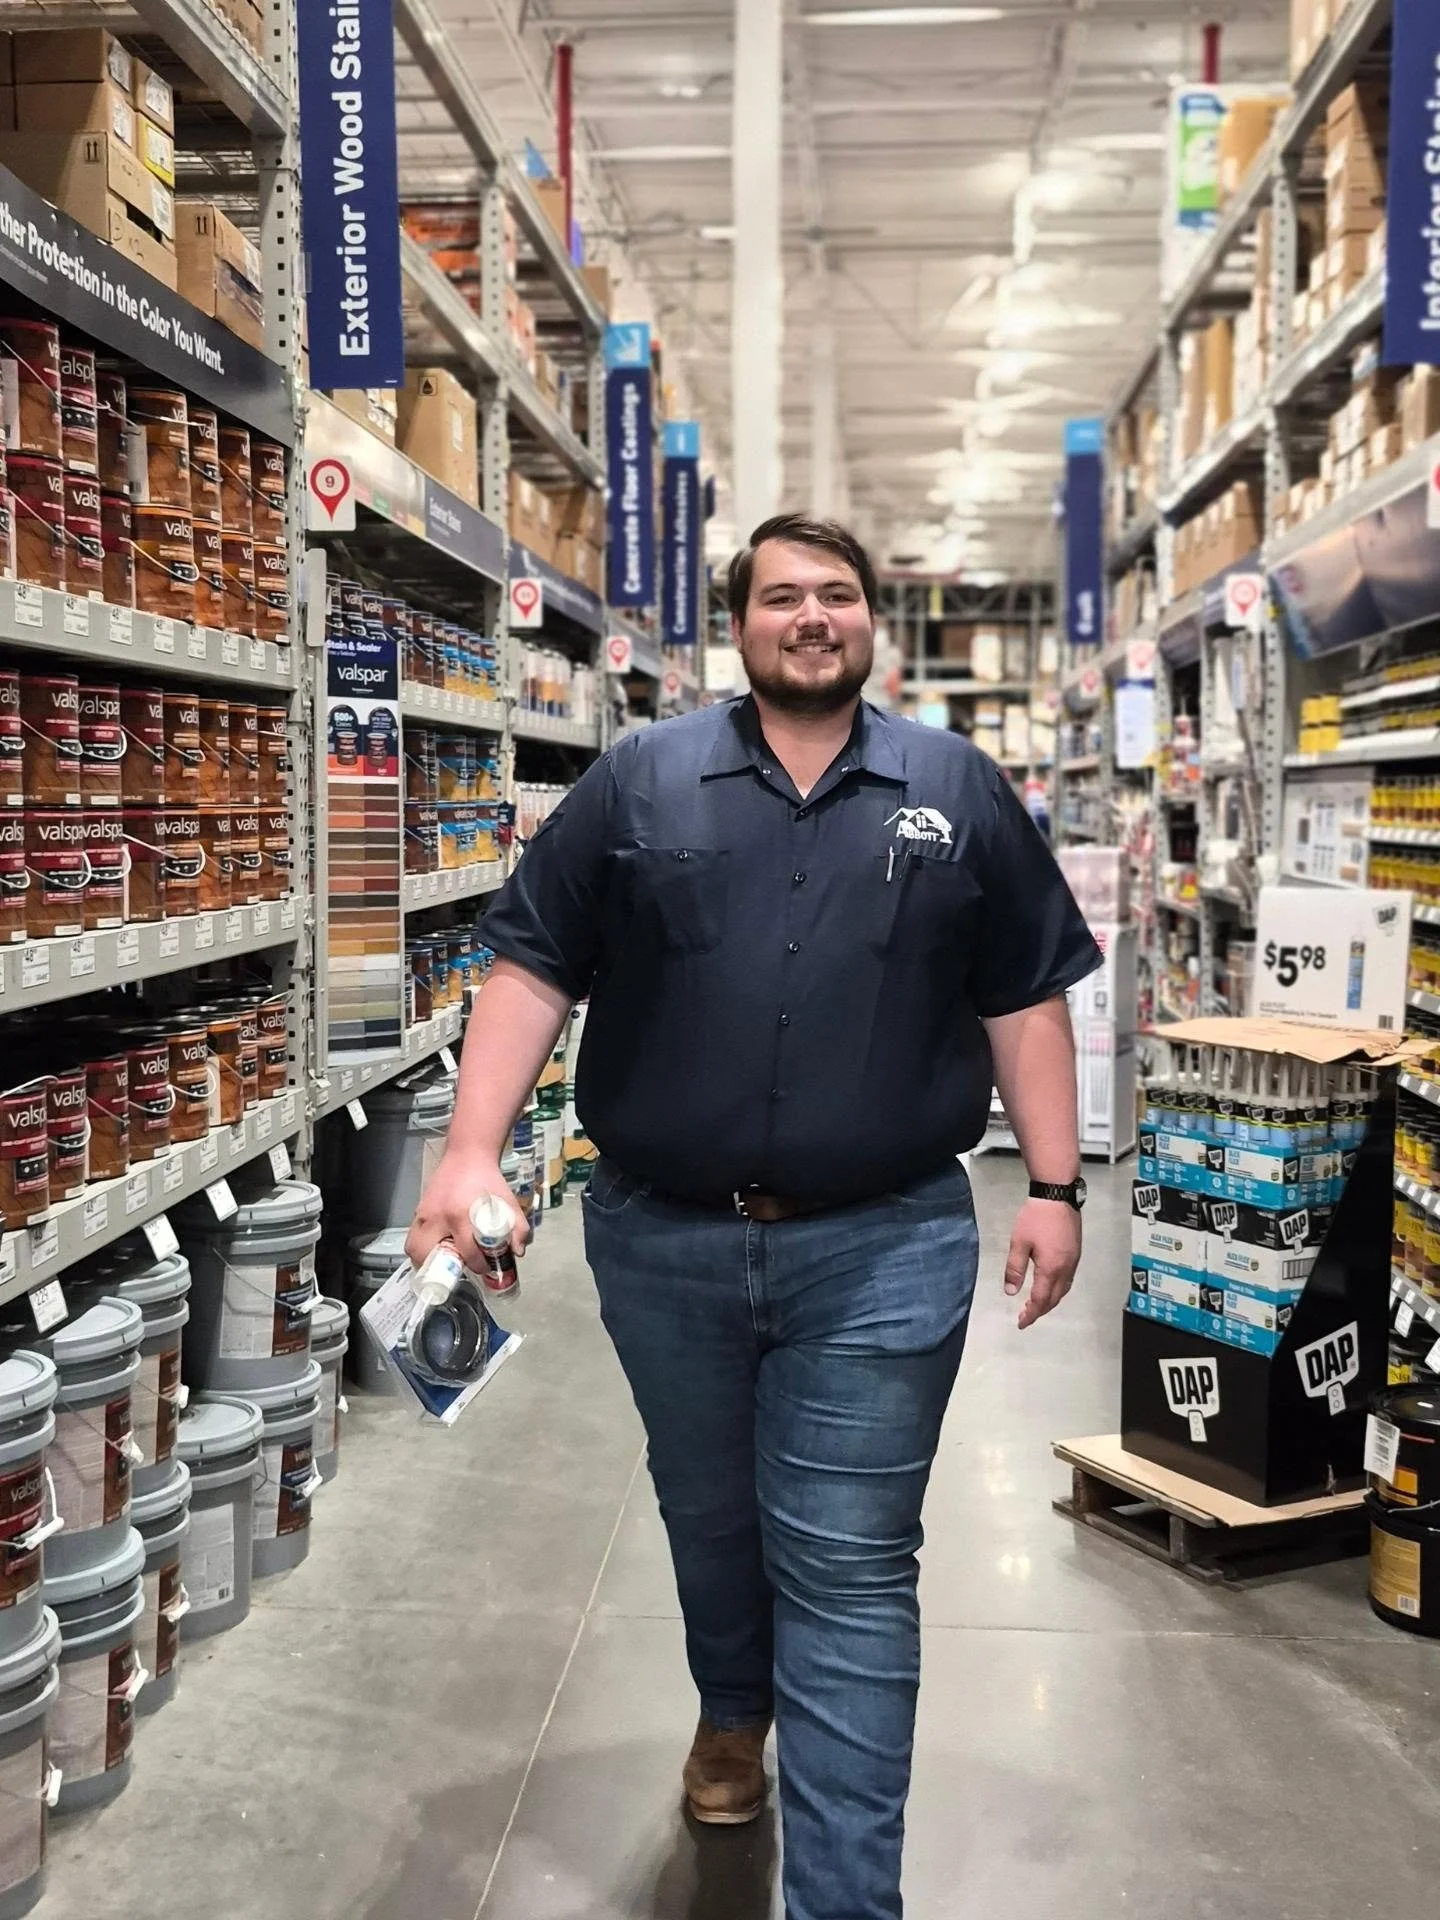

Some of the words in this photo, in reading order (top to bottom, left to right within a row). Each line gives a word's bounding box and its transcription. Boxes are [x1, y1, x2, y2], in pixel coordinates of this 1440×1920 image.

[332, 91, 365, 196] Wood
[338, 203, 371, 356] Exterior
[27, 221, 101, 298] Protection
[102, 271, 115, 306] in
[116, 282, 138, 321] the
[139, 298, 171, 341] Color
[172, 317, 194, 355] You
[194, 331, 225, 376] Want.
[324, 475, 336, 488] 9
[337, 662, 389, 686] valspar
[1137, 1187, 1159, 1209] DAP
[1214, 1204, 1235, 1226] DAP
[1283, 1213, 1307, 1241] DAP
[1304, 1331, 1355, 1390] DAP
[1168, 1365, 1214, 1406] DAP
